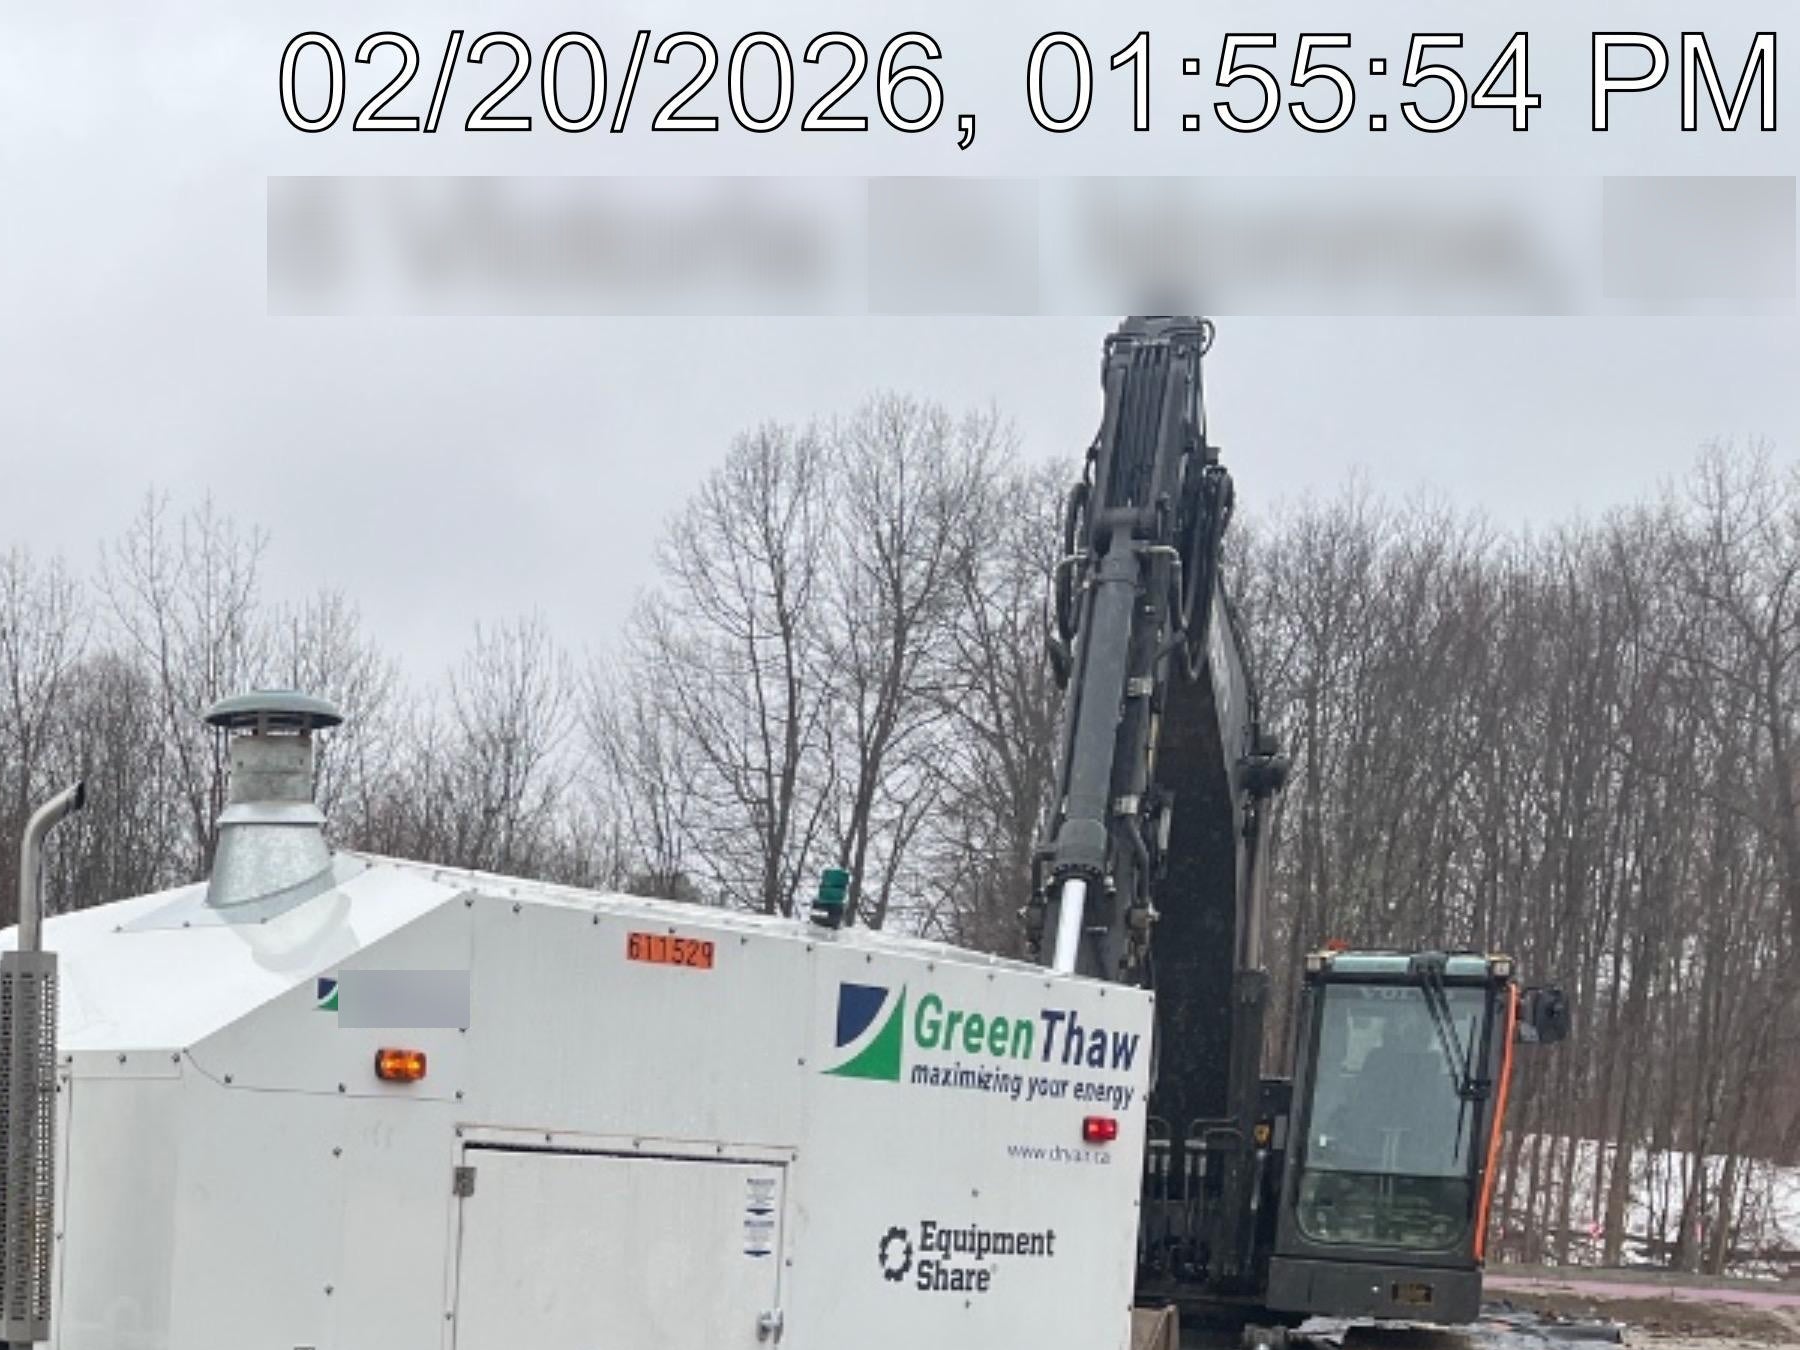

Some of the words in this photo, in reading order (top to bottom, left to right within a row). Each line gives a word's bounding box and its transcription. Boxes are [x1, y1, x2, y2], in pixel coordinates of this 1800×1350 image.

[629, 932, 713, 968] 611529
[915, 993, 1140, 1071] GreenThaw
[911, 1062, 1023, 1100] maximizing
[1026, 1074, 1070, 1101] your
[1073, 1081, 1135, 1110] energy
[920, 1220, 1056, 1261] Equipment
[917, 1260, 992, 1292] Share
